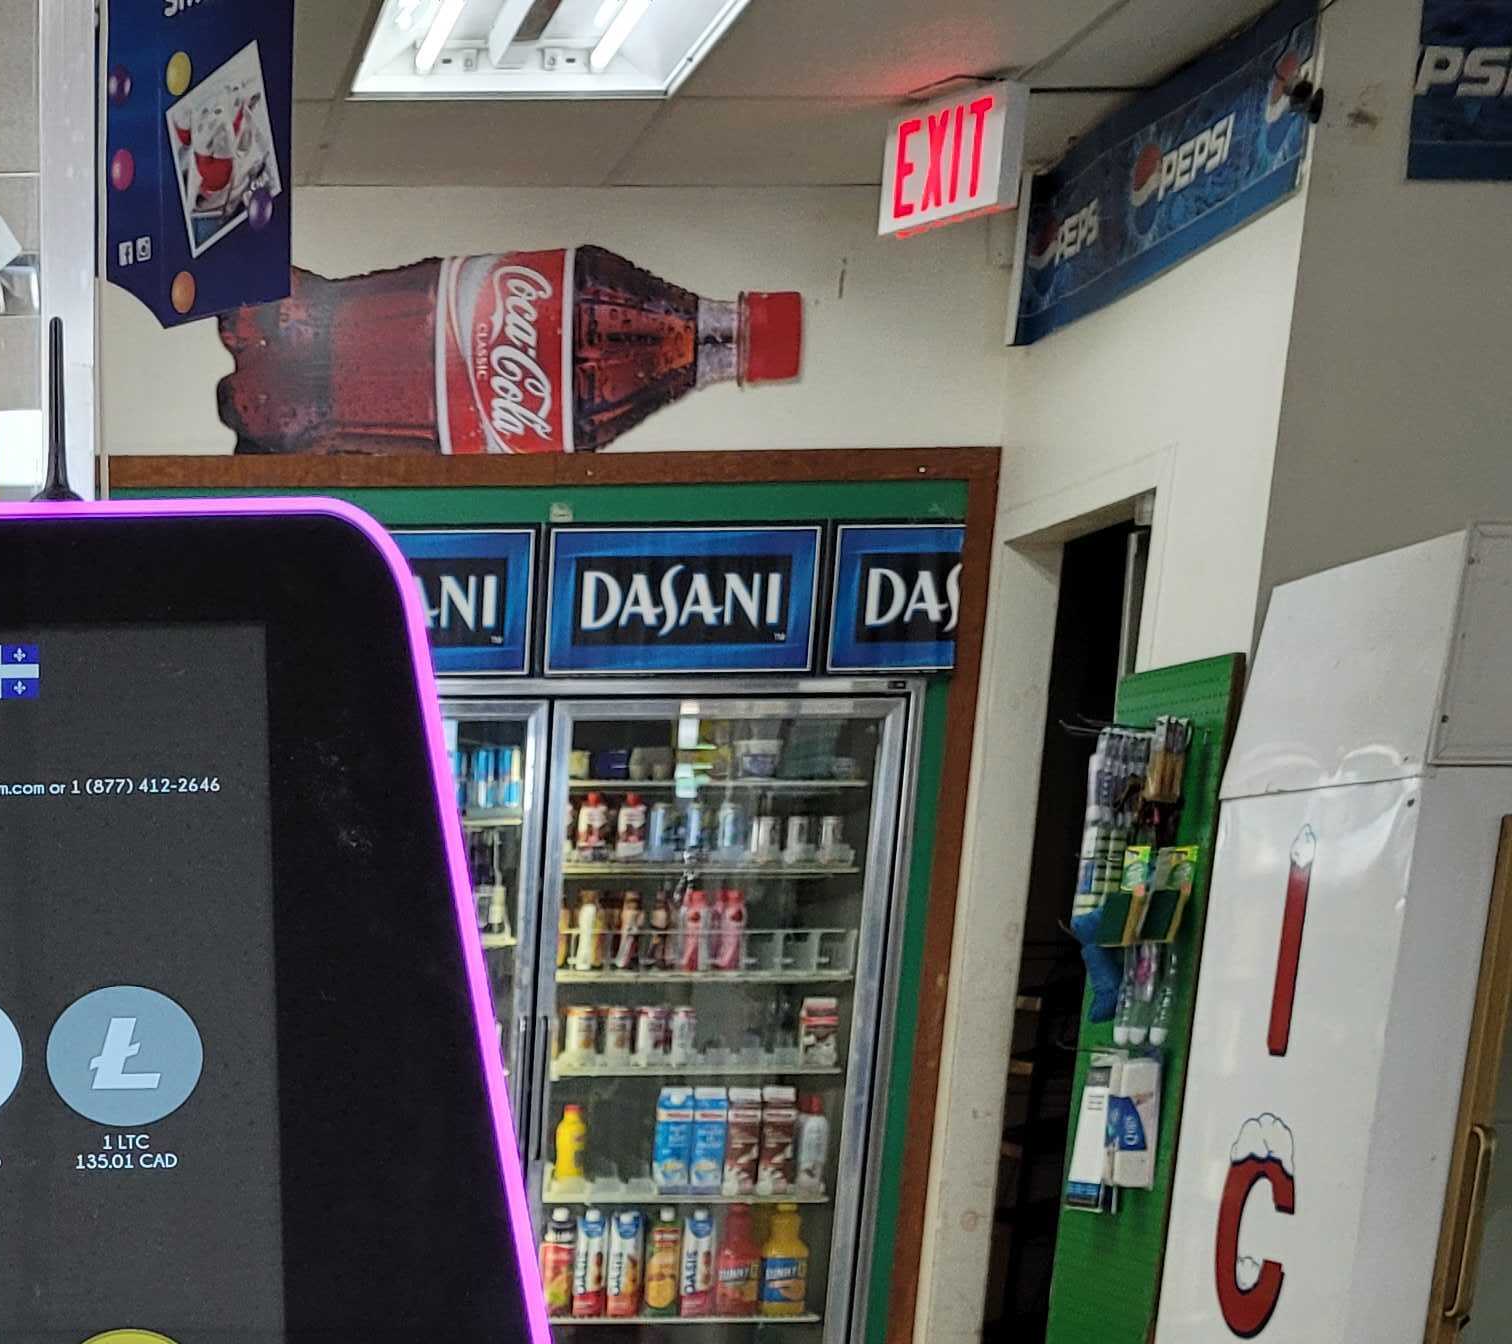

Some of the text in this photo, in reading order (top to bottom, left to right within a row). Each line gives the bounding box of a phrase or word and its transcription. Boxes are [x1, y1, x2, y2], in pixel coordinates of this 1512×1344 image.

[893, 96, 993, 219] EXIT
[1158, 112, 1236, 202] PEPSI
[490, 264, 553, 441] Coca-Cola
[581, 564, 784, 638] DASANI
[49, 784, 66, 795] or
[70, 780, 81, 794] 1
[86, 778, 133, 795] (877)
[138, 777, 221, 793] 412-2646
[74, 1152, 178, 1170] 135.01 CAD
[102, 1134, 151, 1150] 1 LTC
